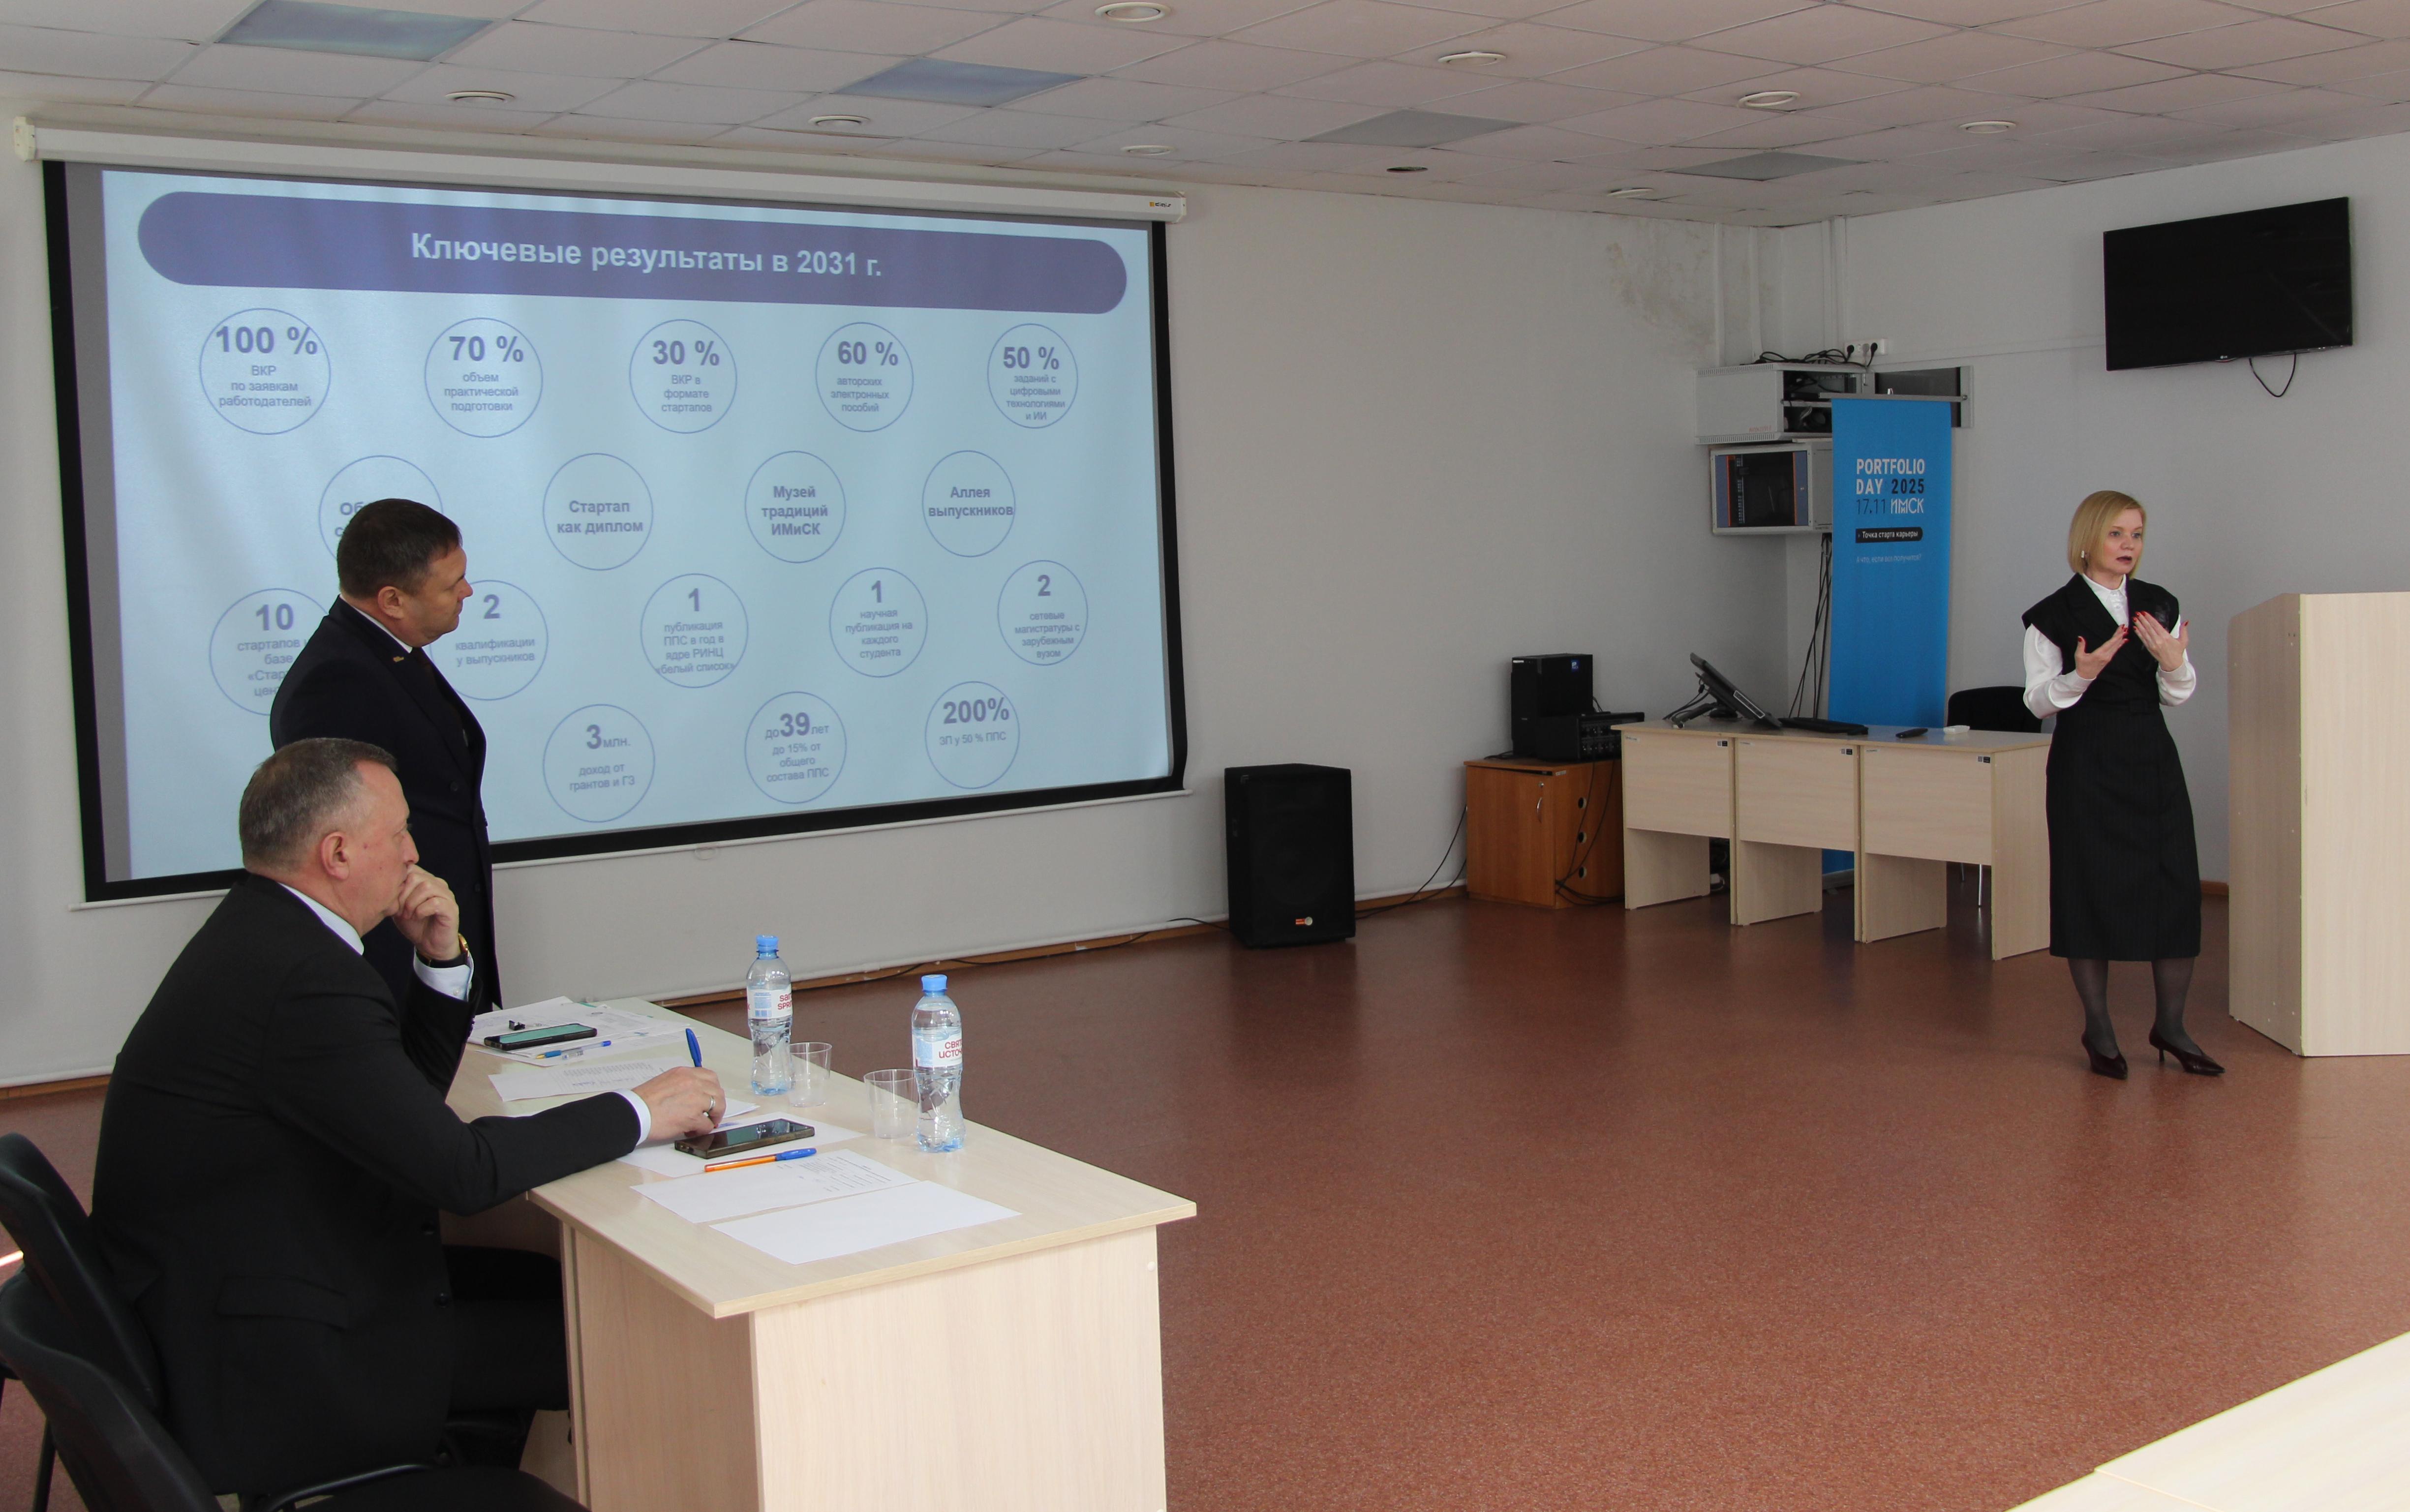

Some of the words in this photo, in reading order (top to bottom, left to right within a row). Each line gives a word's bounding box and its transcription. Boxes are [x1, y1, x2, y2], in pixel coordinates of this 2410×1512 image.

[411, 233, 581, 265] Ключевые
[592, 245, 763, 273] результаты
[772, 256, 788, 272] в
[797, 250, 856, 275] 2031
[867, 258, 882, 276] г.
[216, 326, 275, 353] 100
[287, 327, 318, 354] %
[449, 335, 485, 362] 70
[496, 335, 523, 362] %
[653, 340, 685, 364] 30
[695, 340, 720, 365] %
[838, 341, 866, 364] 60
[876, 341, 898, 365] %
[1004, 346, 1030, 368] 50
[1038, 346, 1059, 369] %
[251, 365, 276, 376] ВКР
[463, 371, 499, 382] объем
[671, 374, 692, 385] ВКР
[837, 378, 882, 387] авторских
[1014, 374, 1049, 384] заданий
[249, 383, 298, 391] заявкам
[444, 386, 519, 398] практической
[1010, 387, 1061, 396] цифровыми
[664, 389, 709, 400] формате
[830, 391, 889, 400] электронных
[219, 395, 312, 408] работодателей
[451, 403, 513, 412] подготовки
[842, 402, 879, 412] пособий
[661, 404, 712, 414] стартапов
[1033, 412, 1047, 420] ИИ
[1857, 458, 1925, 475] PORTFOLIO
[773, 485, 816, 500] Музей
[950, 486, 990, 498] Аллея
[1856, 479, 1883, 495] DAY
[1891, 478, 1924, 494] 2025
[569, 500, 630, 516] Стартап
[762, 505, 828, 520] традиций
[928, 506, 1014, 519] выпускников
[1856, 498, 1886, 514] 17.11
[557, 522, 581, 534] как
[585, 521, 643, 535] диплом
[771, 523, 821, 536] ИМиСК
[871, 580, 882, 603] 1
[1037, 575, 1051, 596] 2
[688, 588, 700, 611] 1
[484, 594, 501, 619] 2
[256, 604, 294, 631] 10
[860, 609, 898, 620] научная
[665, 622, 723, 634] публикация
[846, 623, 900, 635] публикация
[1015, 625, 1072, 634] магистратуры
[237, 639, 301, 652] стартапов
[456, 639, 535, 651] квалификации
[664, 635, 688, 646] ППС
[699, 636, 715, 644] год
[861, 636, 898, 645] каждого
[1022, 635, 1074, 647] зарубежным
[265, 654, 293, 665] базе
[457, 658, 463, 667] у
[466, 653, 535, 665] выпускников
[666, 651, 690, 661] ядре
[693, 647, 724, 658] РИНЦ
[860, 649, 901, 660] студента
[1037, 650, 1061, 660] вузом
[248, 670, 286, 681] «Стар
[943, 697, 1009, 724] 200%
[954, 737, 960, 746] у
[962, 734, 973, 743] 50
[975, 733, 983, 742] %
[986, 731, 1007, 742] ППС
[772, 747, 785, 756] до
[788, 743, 808, 753] 15%
[780, 757, 815, 767] общего
[579, 765, 610, 777] доход
[613, 764, 625, 772] от
[766, 771, 804, 782] состава
[807, 767, 829, 778] ППС
[569, 779, 610, 792] грантов
[945, 1039, 962, 1049] СВЯТ
